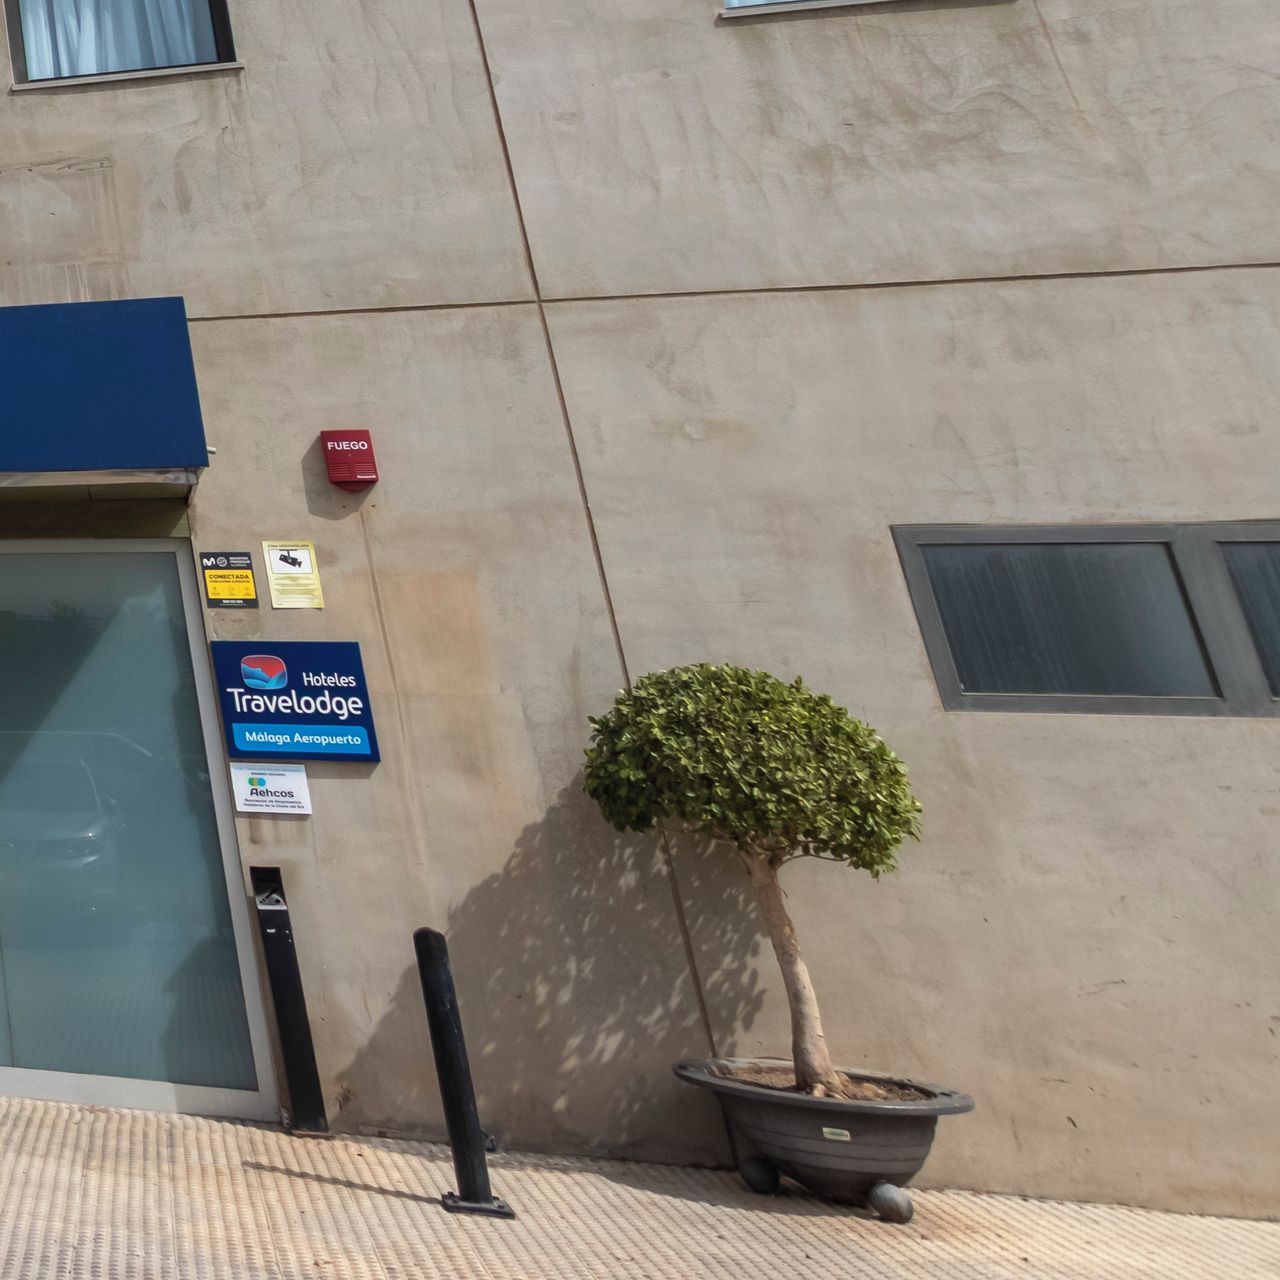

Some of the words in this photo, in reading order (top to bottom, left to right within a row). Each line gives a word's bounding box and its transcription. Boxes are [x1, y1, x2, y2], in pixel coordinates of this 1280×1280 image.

[327, 441, 368, 450] FUEGO
[302, 672, 357, 687] Hoteles
[226, 688, 363, 720] Travelodge
[245, 731, 290, 745] Málaga
[294, 733, 361, 746] Aeropuerto
[250, 788, 294, 798] Aehcos
